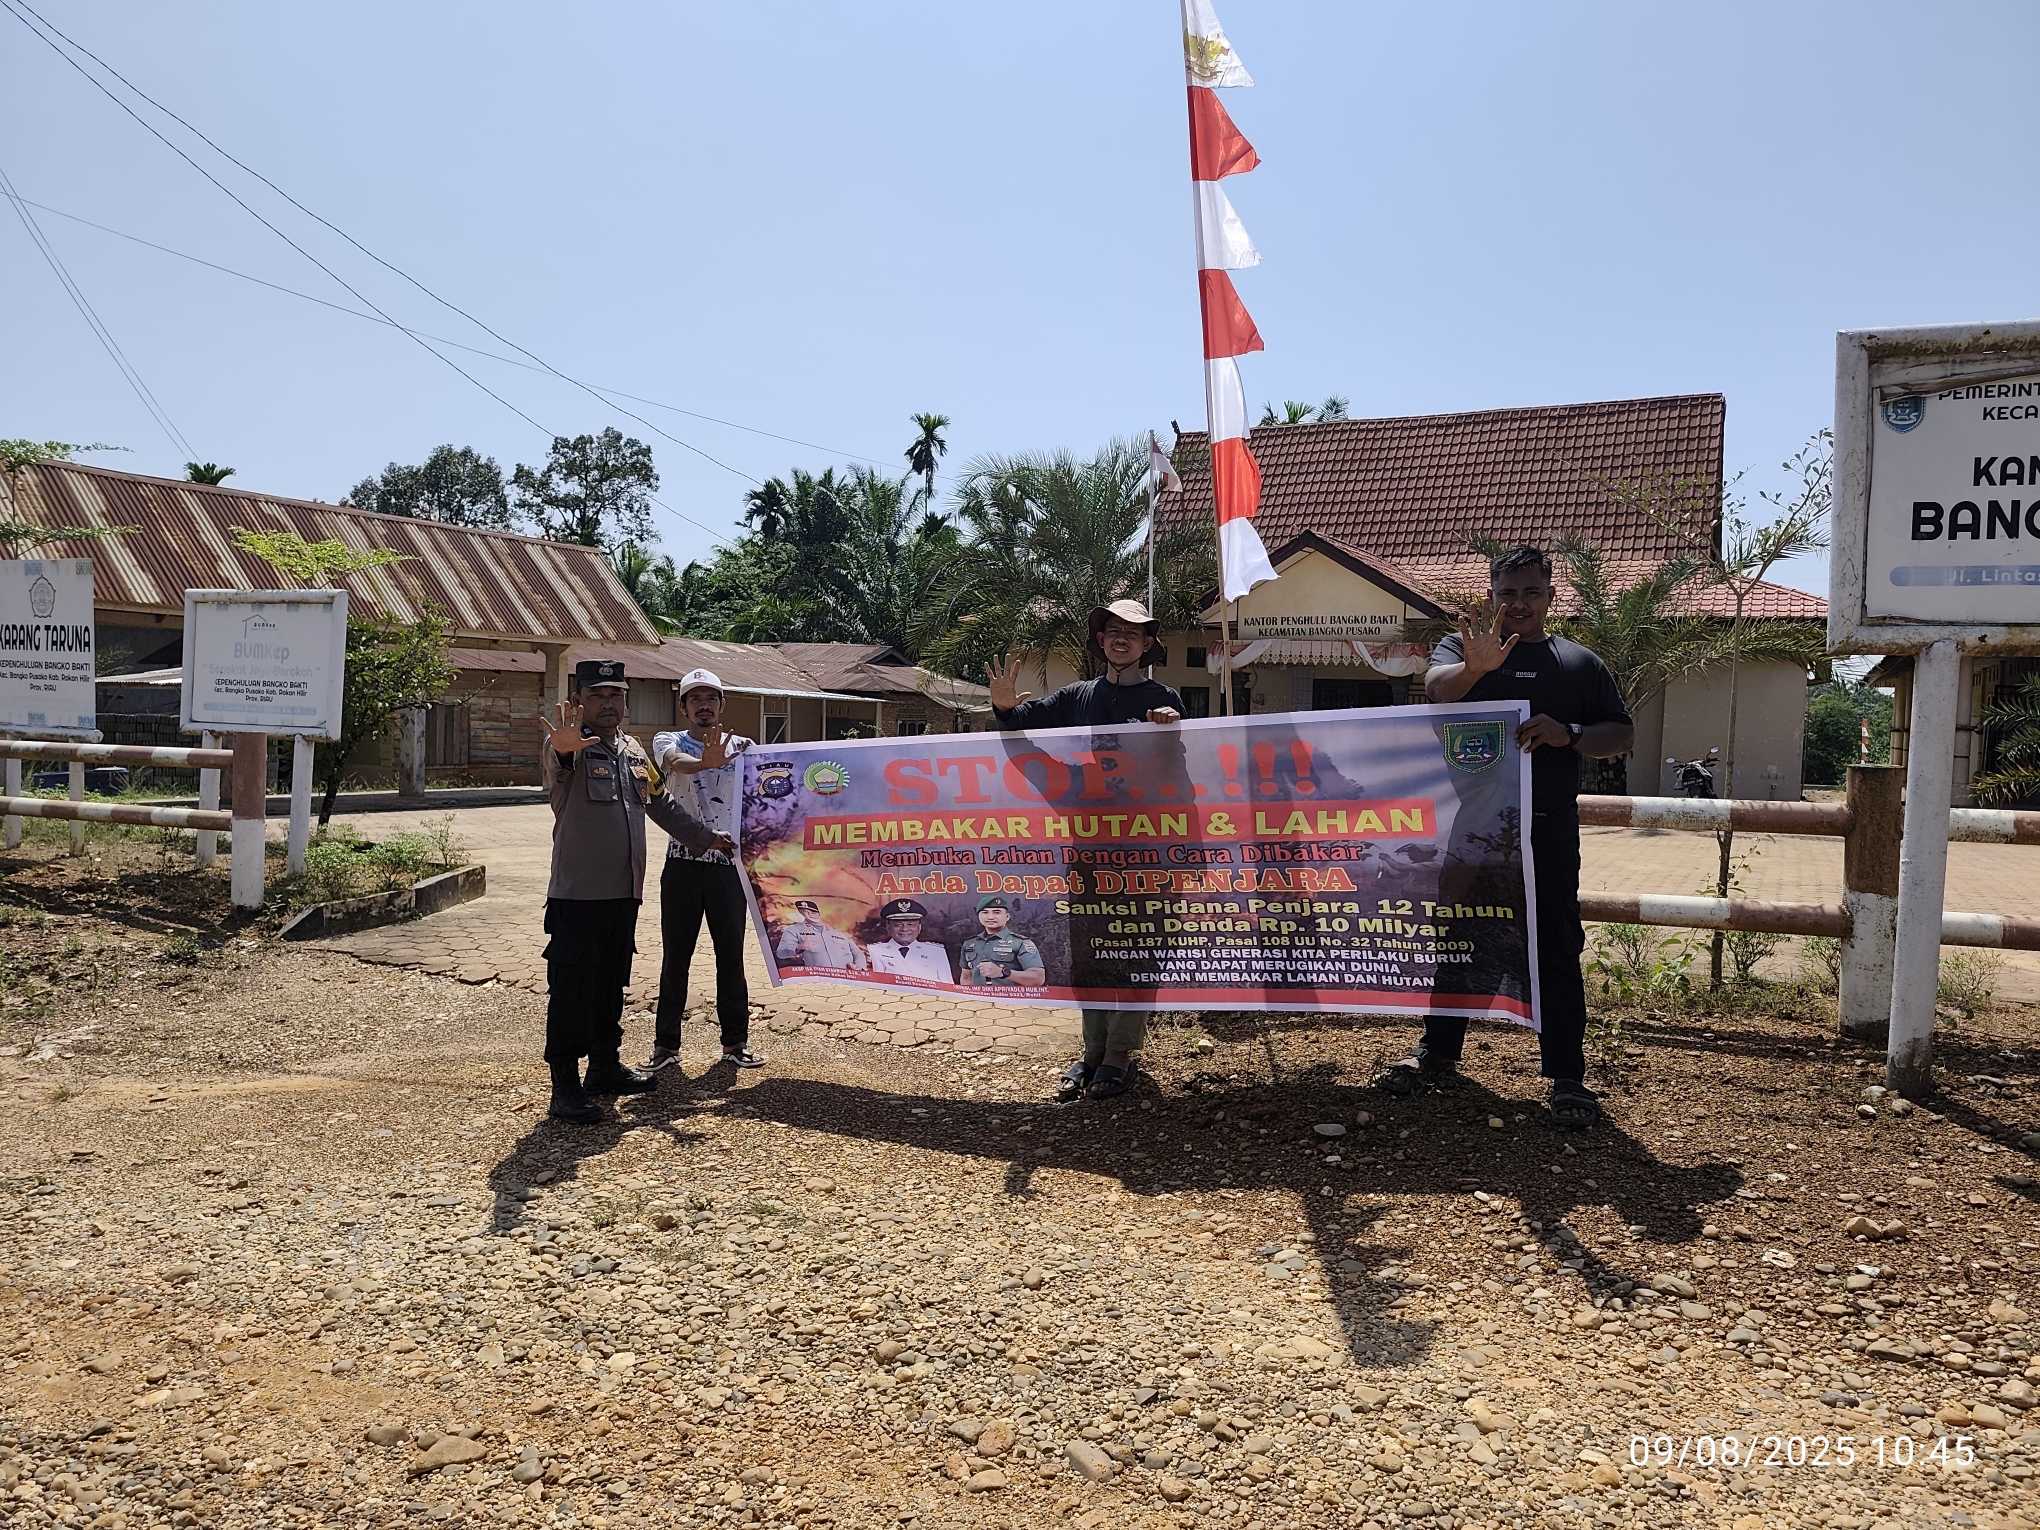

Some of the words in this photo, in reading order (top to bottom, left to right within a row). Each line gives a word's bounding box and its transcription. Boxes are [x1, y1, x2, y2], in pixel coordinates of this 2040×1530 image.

[1982, 405, 2039, 421] KECA
[1244, 616, 1278, 627] KANTOR
[1280, 615, 1327, 626] PENGHULU
[1329, 615, 1367, 625] BANGKO
[1370, 615, 1398, 625] BAKTI
[44, 625, 91, 653] TARUNA
[1258, 627, 1307, 637] KECAMATAN
[1308, 627, 1344, 636] BANGKO
[1345, 626, 1381, 636] PUSAKO
[44, 661, 70, 671] BANGKO
[71, 662, 91, 672] BAKTI
[61, 673, 78, 682] Rokan
[262, 680, 289, 688] BANGKO
[289, 681, 308, 689] BAKTI
[225, 686, 245, 694] Bangko
[278, 688, 296, 696] Rokan
[813, 816, 1032, 845] MEMBAKAR
[1044, 813, 1188, 838] HUTAN
[1205, 811, 1238, 836] &
[1254, 808, 1424, 836] LAHAN
[861, 847, 976, 868] Membuka
[981, 845, 1055, 865] Lahan
[1061, 845, 1160, 868] Dengan
[1167, 844, 1234, 864] Cara
[1240, 843, 1363, 864] Dibakar
[874, 870, 969, 896] Anda
[974, 869, 1085, 900] Dapat
[1094, 867, 1358, 895] DIPENJARA
[1054, 899, 1138, 916] Sanksi
[1144, 899, 1240, 915] Pidana
[1247, 898, 1361, 917] Penjara
[1377, 899, 1414, 915] 12
[1420, 900, 1514, 920] Tahun
[1107, 919, 1156, 934] dan
[1163, 917, 1251, 933] Denda
[1258, 917, 1306, 935] Rp.
[1314, 917, 1350, 933] 10
[1358, 917, 1450, 938] Milyar
[1090, 937, 1133, 949] (Pasal
[1137, 936, 1163, 947] 187
[1167, 936, 1212, 948] KUHP,
[1215, 936, 1258, 946] Pasal
[1262, 936, 1290, 946] 108
[1295, 936, 1316, 947] UU
[1320, 937, 1347, 947] No.
[1350, 937, 1371, 948] 32
[1374, 937, 1422, 951] Tahun
[1425, 940, 1475, 952] 2009)
[1094, 949, 1149, 960] JANGAN
[1153, 949, 1207, 959] WARISI
[1210, 949, 1287, 959] GENERASI
[1292, 949, 1326, 959] KITA
[1330, 949, 1409, 963] PERILAKU
[1413, 953, 1473, 965] BURUK
[1157, 961, 1197, 971] YANG
[1200, 960, 1247, 971] DAPAT
[1251, 960, 1346, 972] MERUGIKAN
[1350, 962, 1400, 974] DUNIA
[1130, 973, 1191, 983] DENGAN
[1194, 972, 1283, 983] MEMBAKAR
[1287, 973, 1340, 984] LAHAN
[1344, 974, 1378, 985] DAN
[1381, 976, 1435, 987] HUTAN
